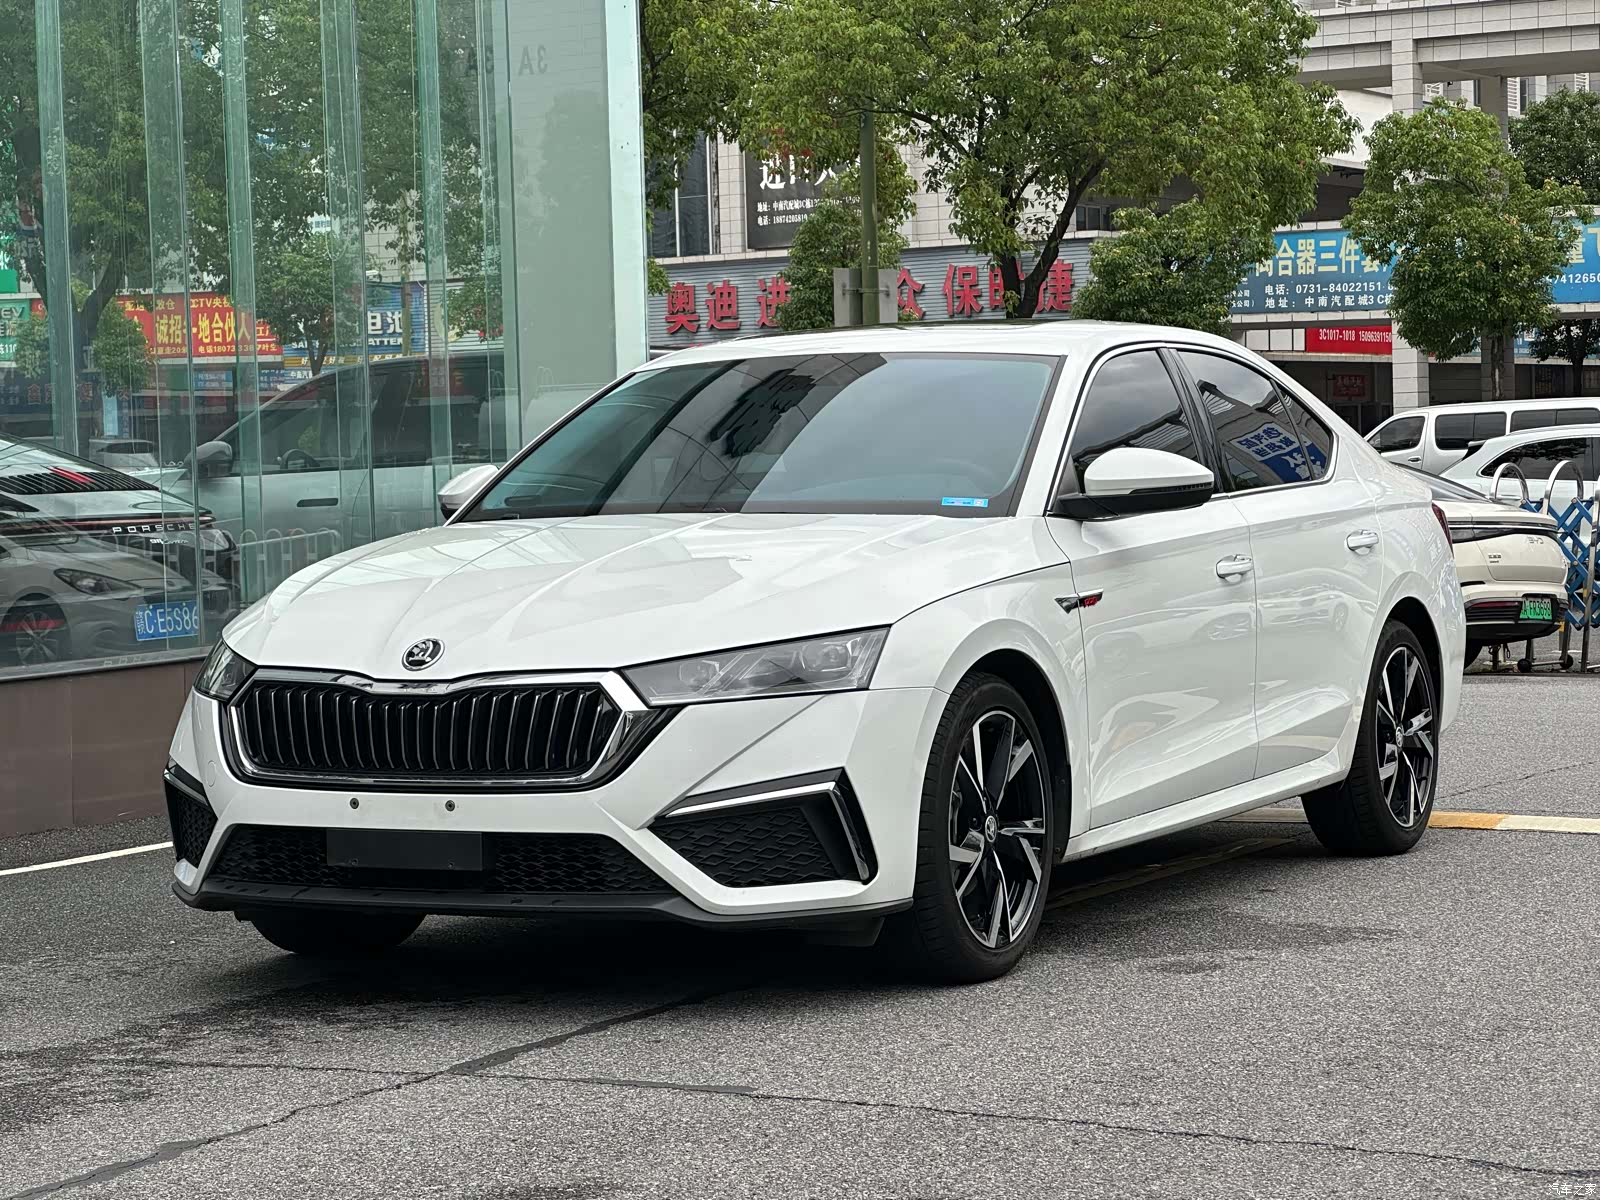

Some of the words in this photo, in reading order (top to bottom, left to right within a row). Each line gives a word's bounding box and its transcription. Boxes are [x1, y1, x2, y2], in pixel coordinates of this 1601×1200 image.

[1296, 282, 1381, 294] 0731-84022151
[665, 279, 741, 334] 奥迪
[112, 523, 197, 534] PORSCHE
